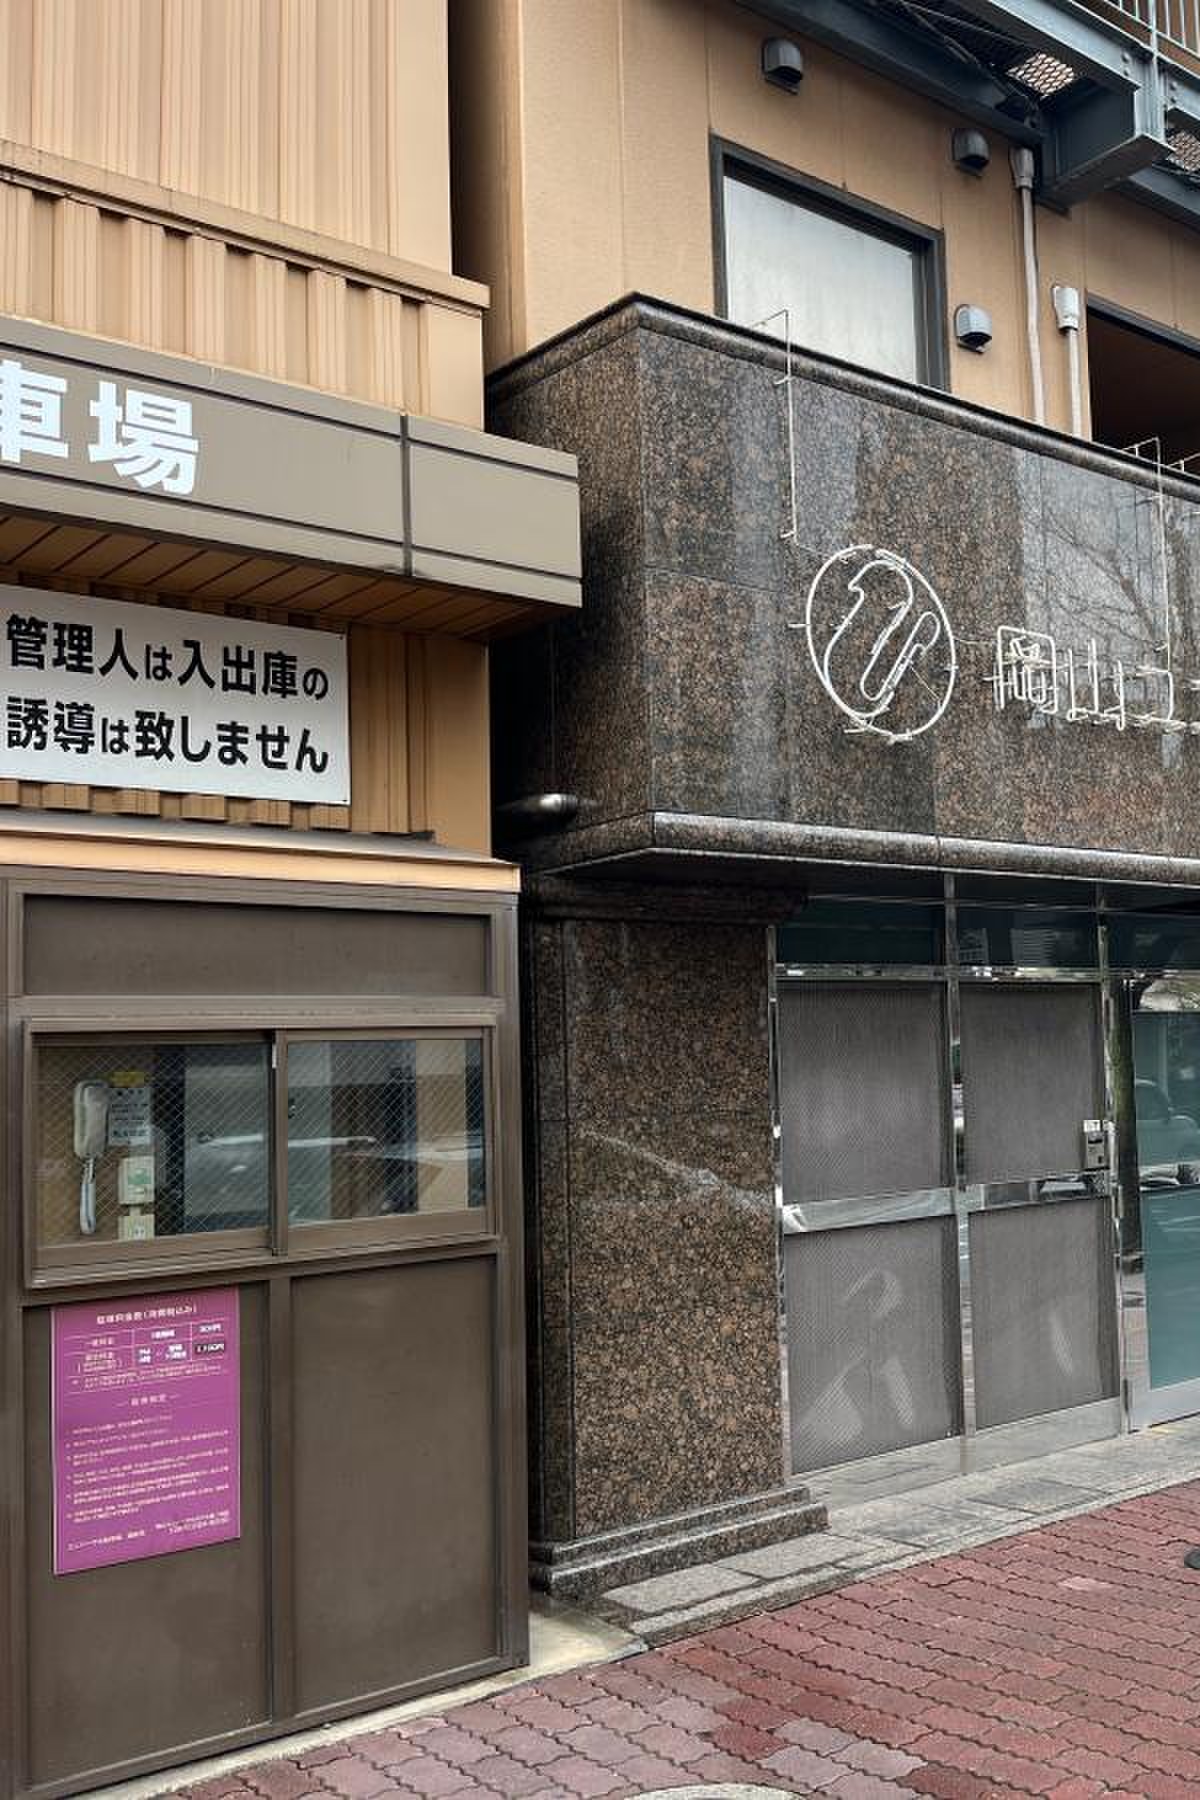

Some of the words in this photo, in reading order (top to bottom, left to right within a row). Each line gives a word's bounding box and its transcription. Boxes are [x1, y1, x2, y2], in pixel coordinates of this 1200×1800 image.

[0, 359, 198, 495] 車場
[6, 614, 329, 701] 管理人は入出庫の
[6, 697, 329, 774] 誘導は致しません
